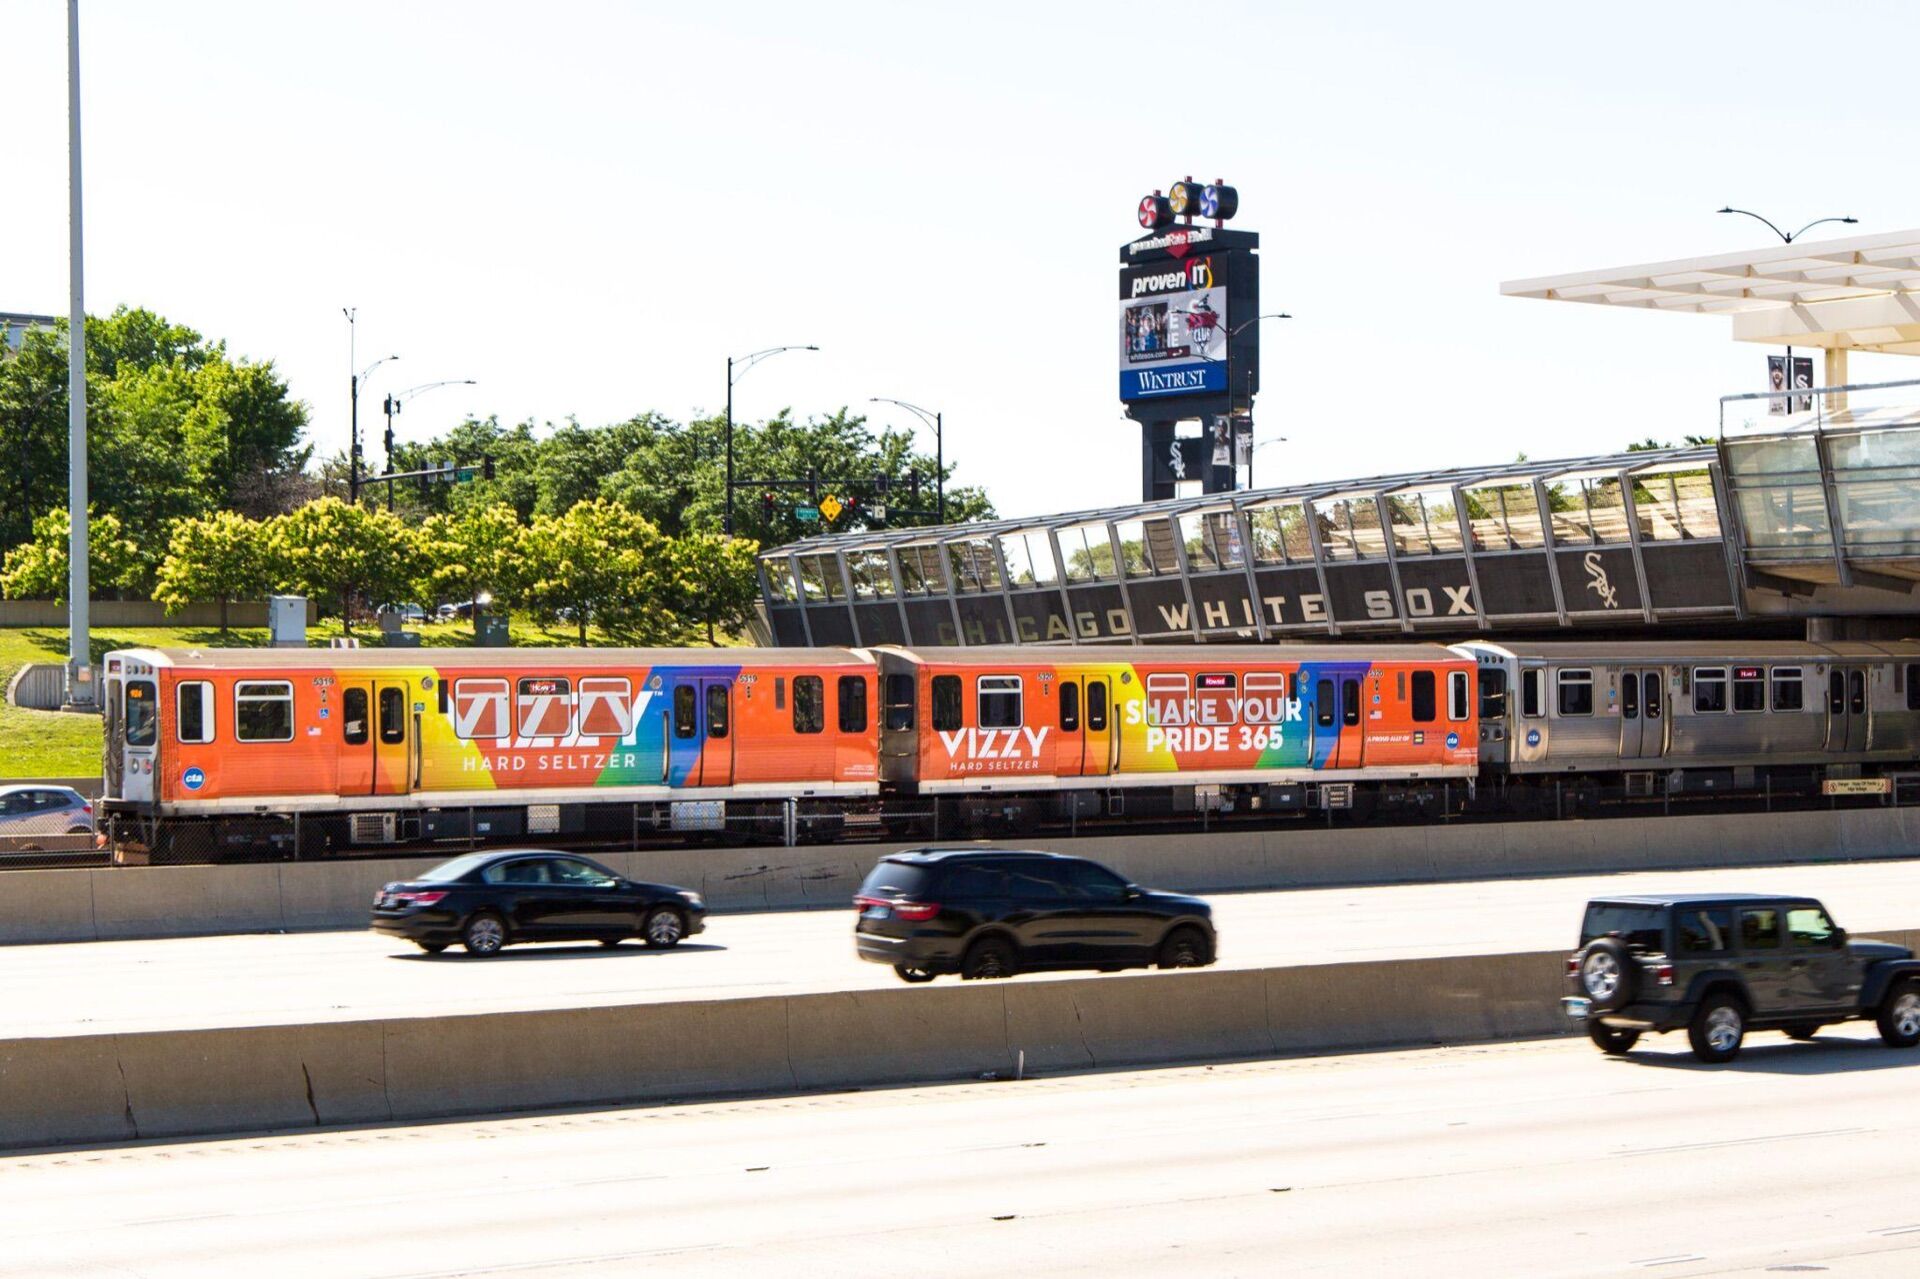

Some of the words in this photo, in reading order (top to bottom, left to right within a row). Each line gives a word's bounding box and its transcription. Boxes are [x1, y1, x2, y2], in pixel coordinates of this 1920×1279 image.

[1131, 271, 1187, 298] proven
[1192, 264, 1206, 285] IT
[938, 608, 1132, 646] CHICAGO
[1158, 594, 1328, 631] WHITE
[1364, 586, 1477, 618] SOX
[436, 690, 653, 749] VIZZY
[1126, 699, 1218, 725] SHARE
[1226, 697, 1303, 724] YOUR
[939, 726, 1050, 759] VIZZY
[1147, 727, 1230, 753] PRIDE
[1238, 726, 1284, 750] 365
[463, 756, 526, 771] HARD
[538, 753, 637, 770] SELTZER
[950, 762, 983, 772] HARD
[988, 760, 1040, 770] SELTZER
